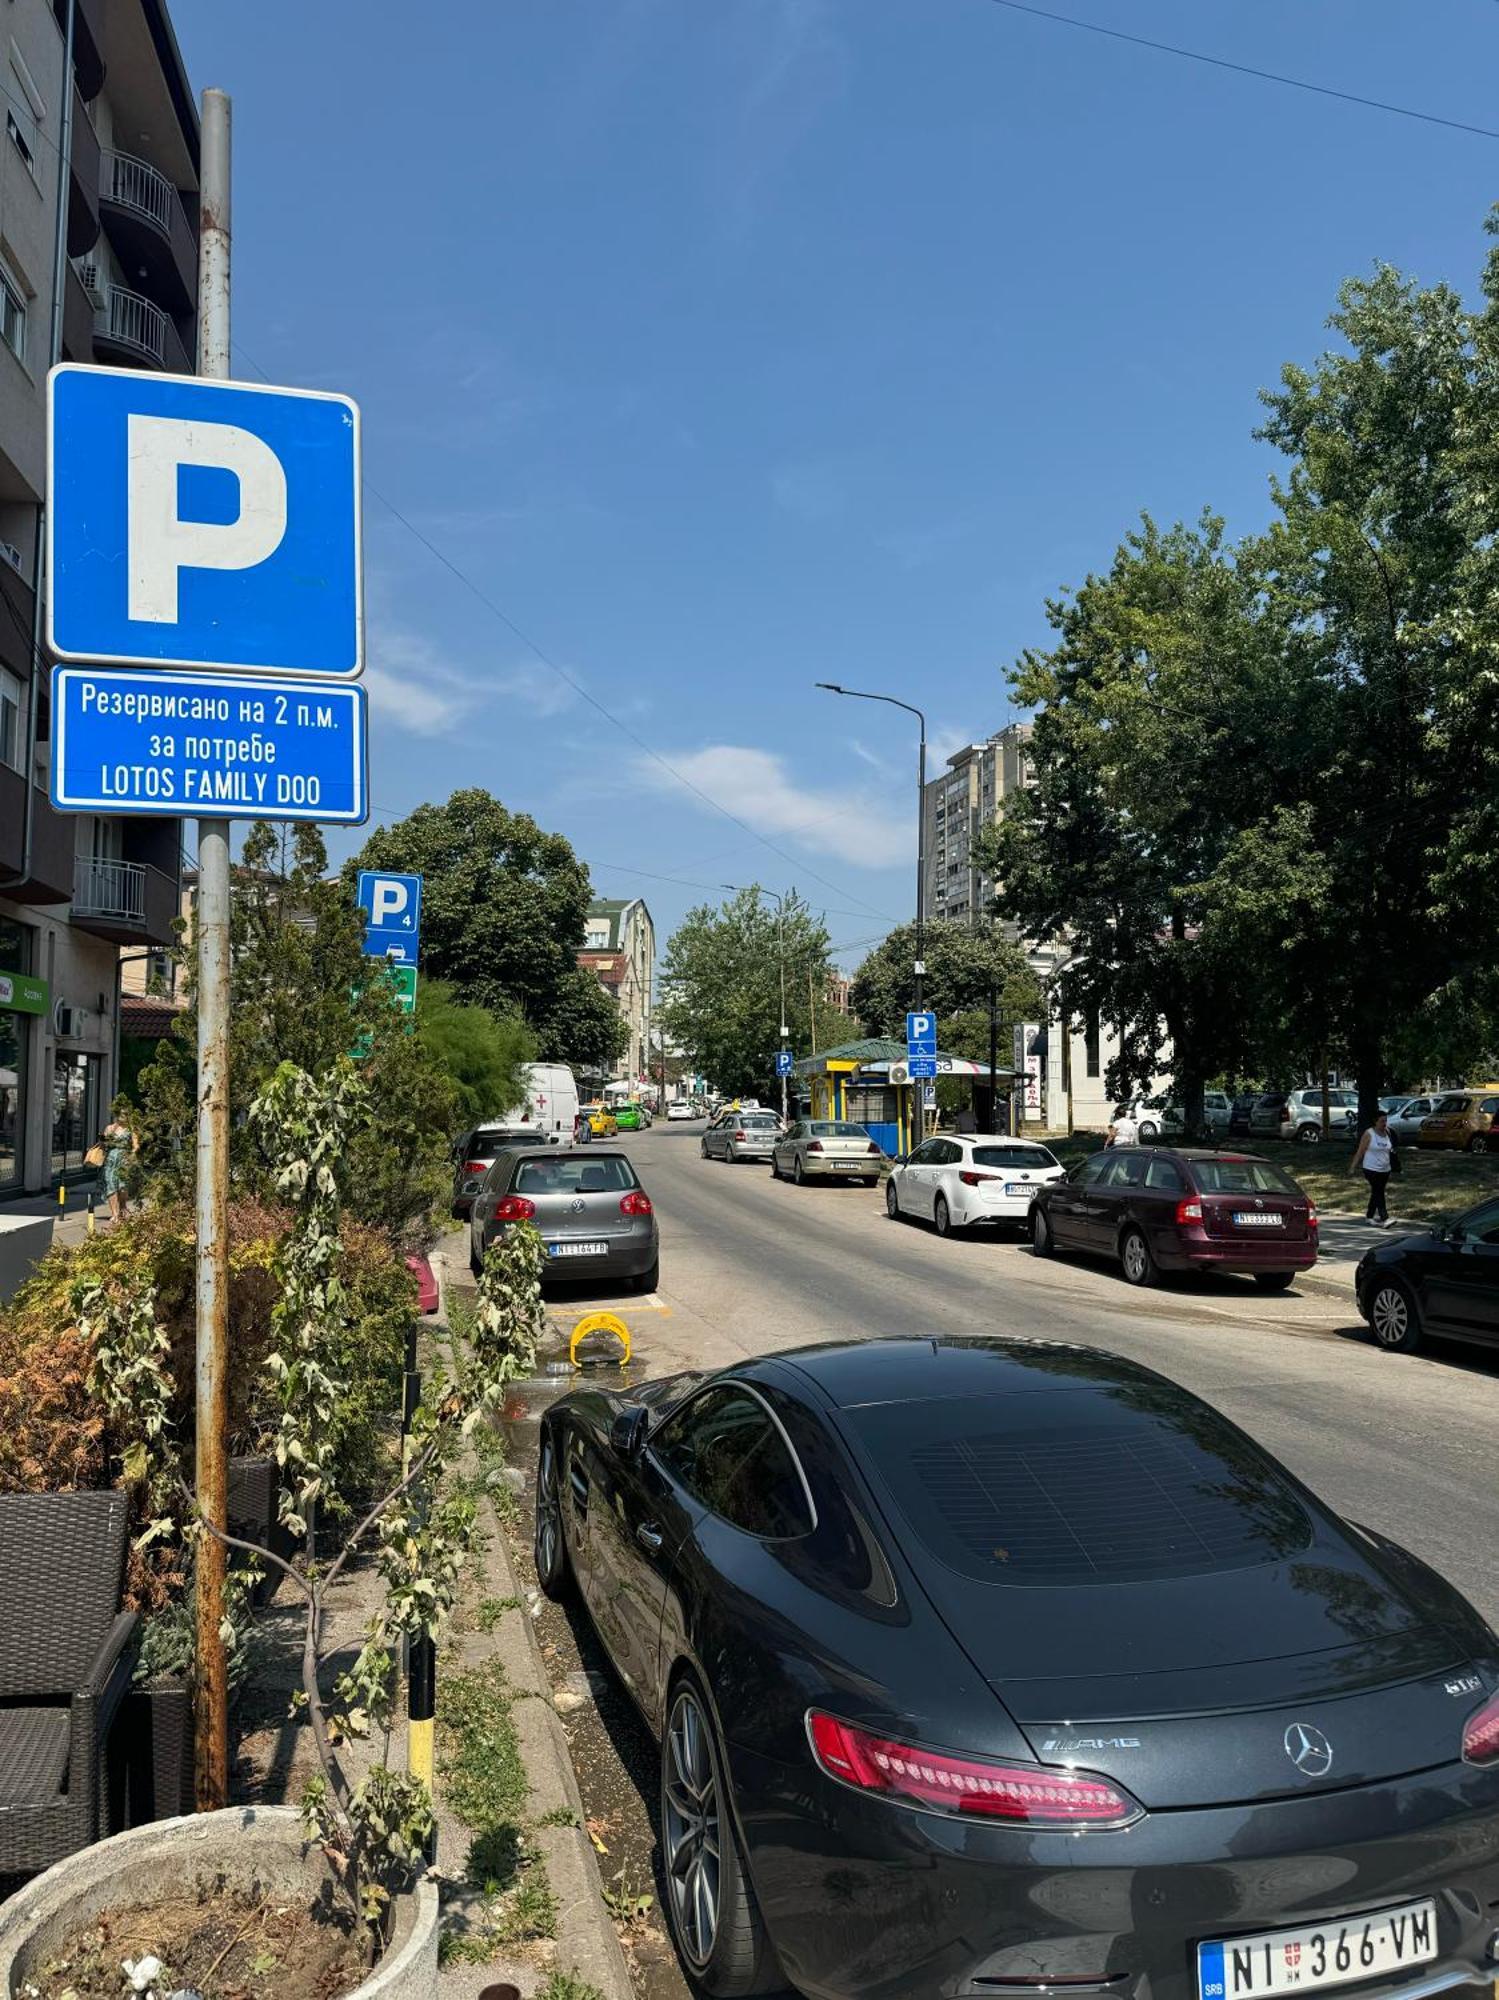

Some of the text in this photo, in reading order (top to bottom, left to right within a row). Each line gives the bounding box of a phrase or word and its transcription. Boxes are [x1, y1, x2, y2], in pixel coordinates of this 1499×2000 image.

[128, 413, 287, 624] P
[82, 683, 339, 728] Резервисано на 2 п.м.
[149, 733, 276, 767] за потребе
[101, 765, 320, 804] LOTOS FAMILY DOO
[372, 880, 407, 924] P
[402, 915, 411, 927] 4
[913, 1017, 929, 1038] P
[780, 1055, 789, 1066] P
[927, 1087, 934, 1097] P
[1074, 1738, 1140, 1749] AMG
[1232, 1944, 1272, 1992] NI
[1205, 1983, 1223, 1996] SRB
